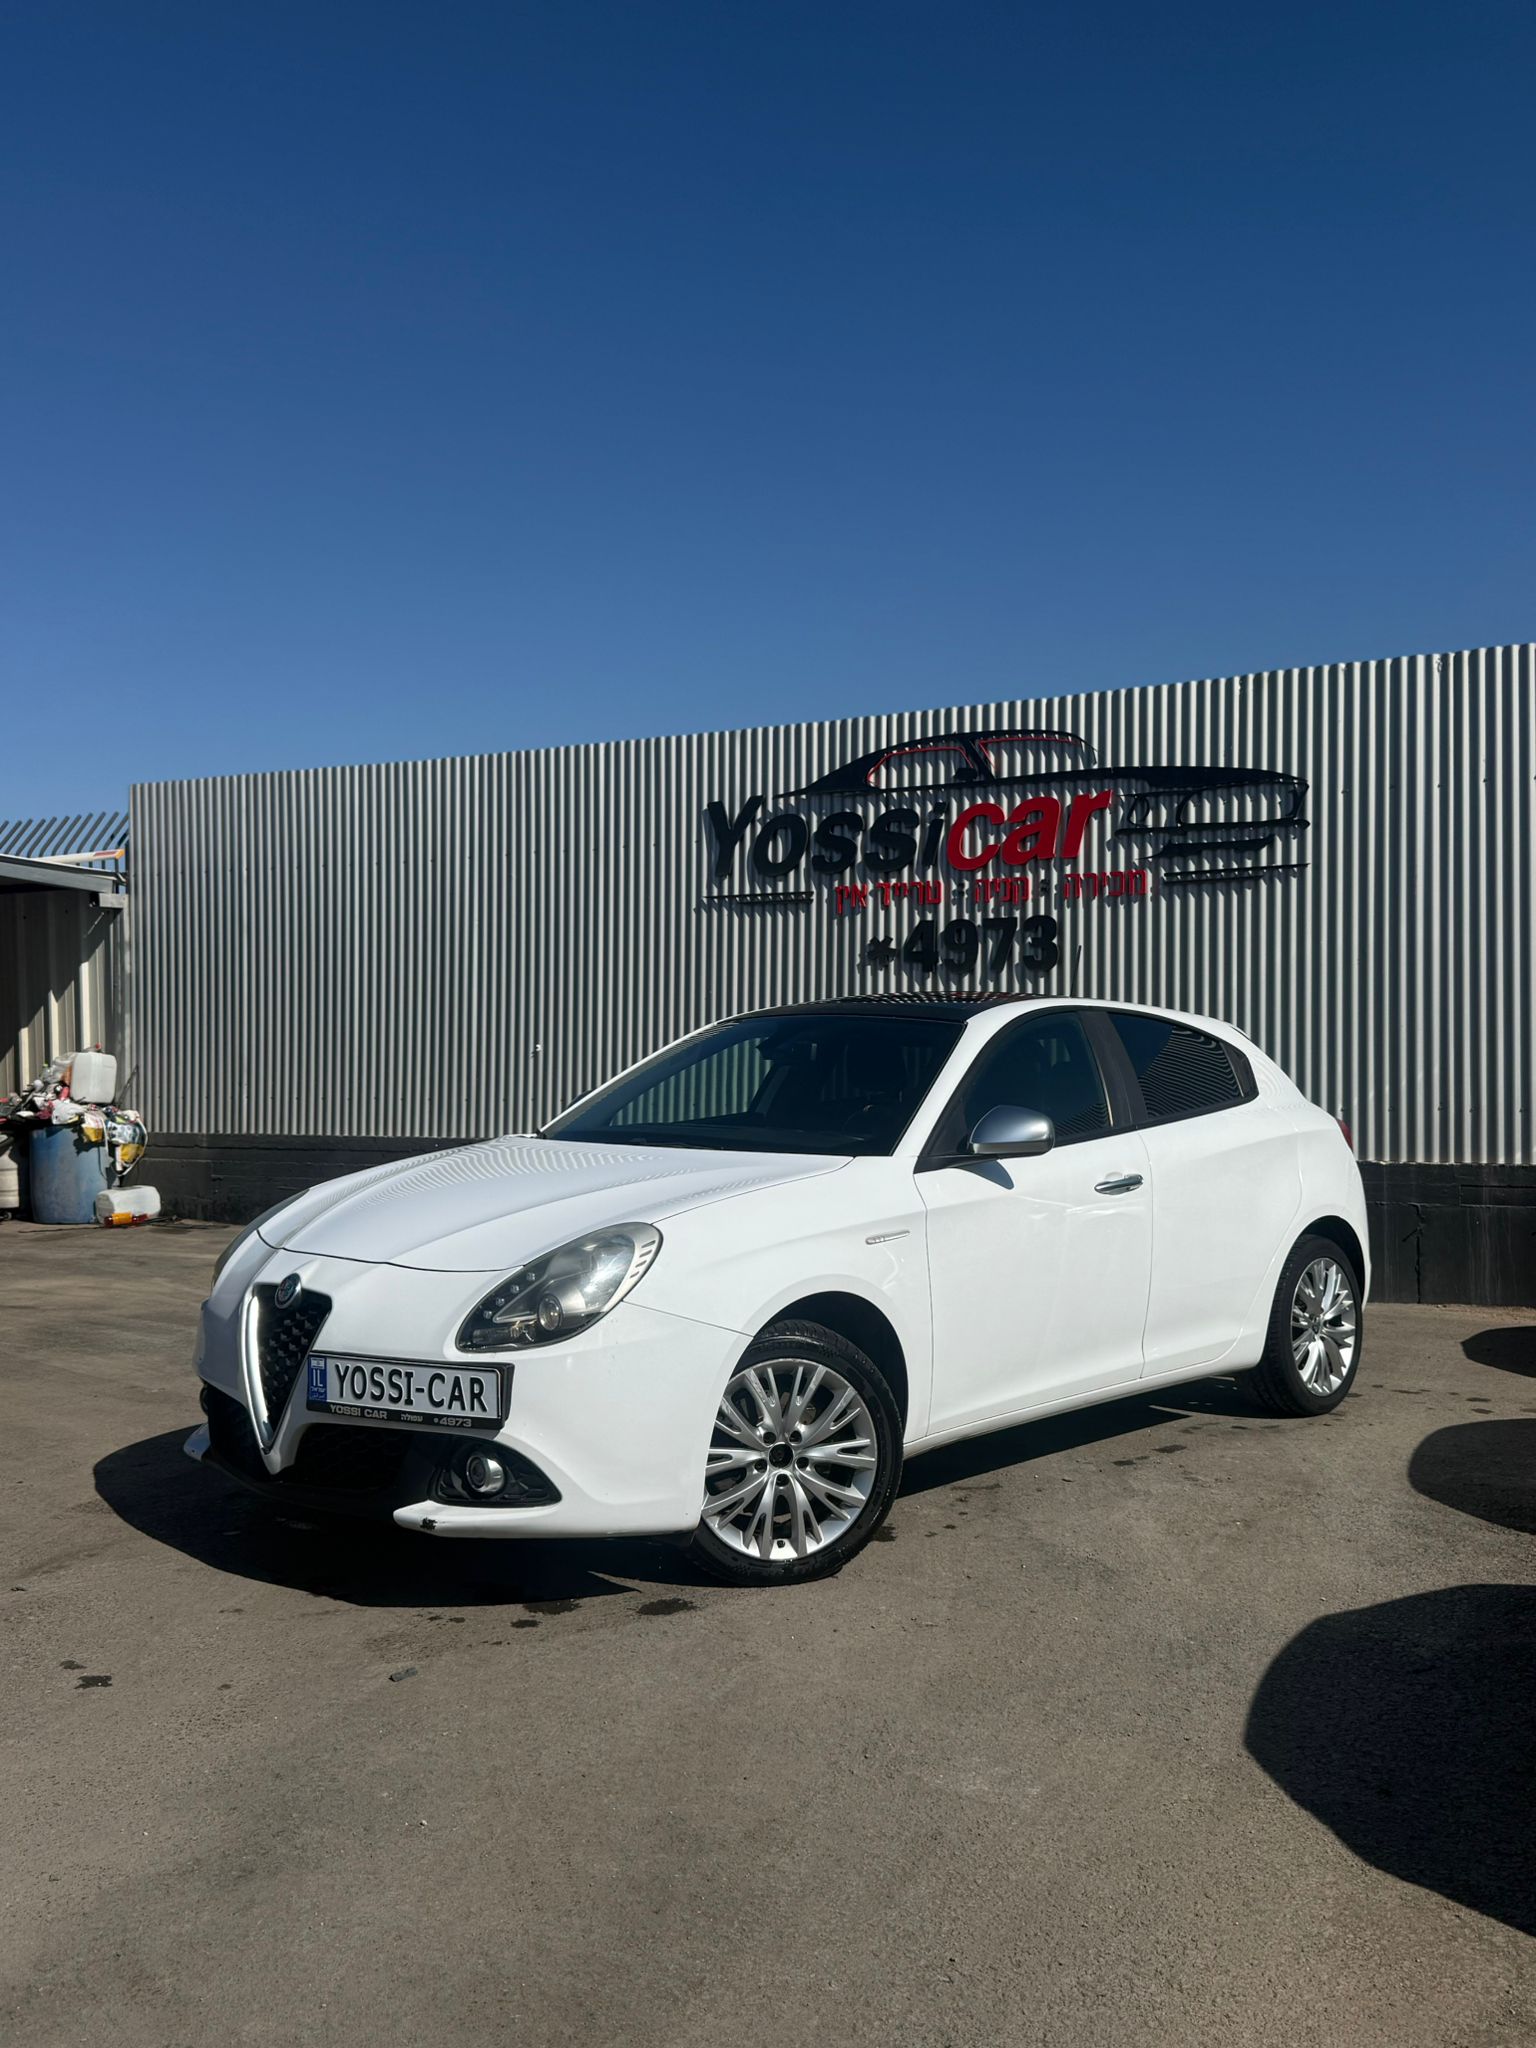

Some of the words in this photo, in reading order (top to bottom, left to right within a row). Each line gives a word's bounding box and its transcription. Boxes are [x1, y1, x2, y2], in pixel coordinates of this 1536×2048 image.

[834, 883, 868, 915] אין
[876, 880, 942, 907] טרייד
[975, 877, 1030, 905] קניה
[1064, 869, 1147, 900] מכירה
[335, 1363, 488, 1412] YOSSI-CAR
[330, 1404, 361, 1416] YOSSI
[364, 1408, 387, 1419] CAR
